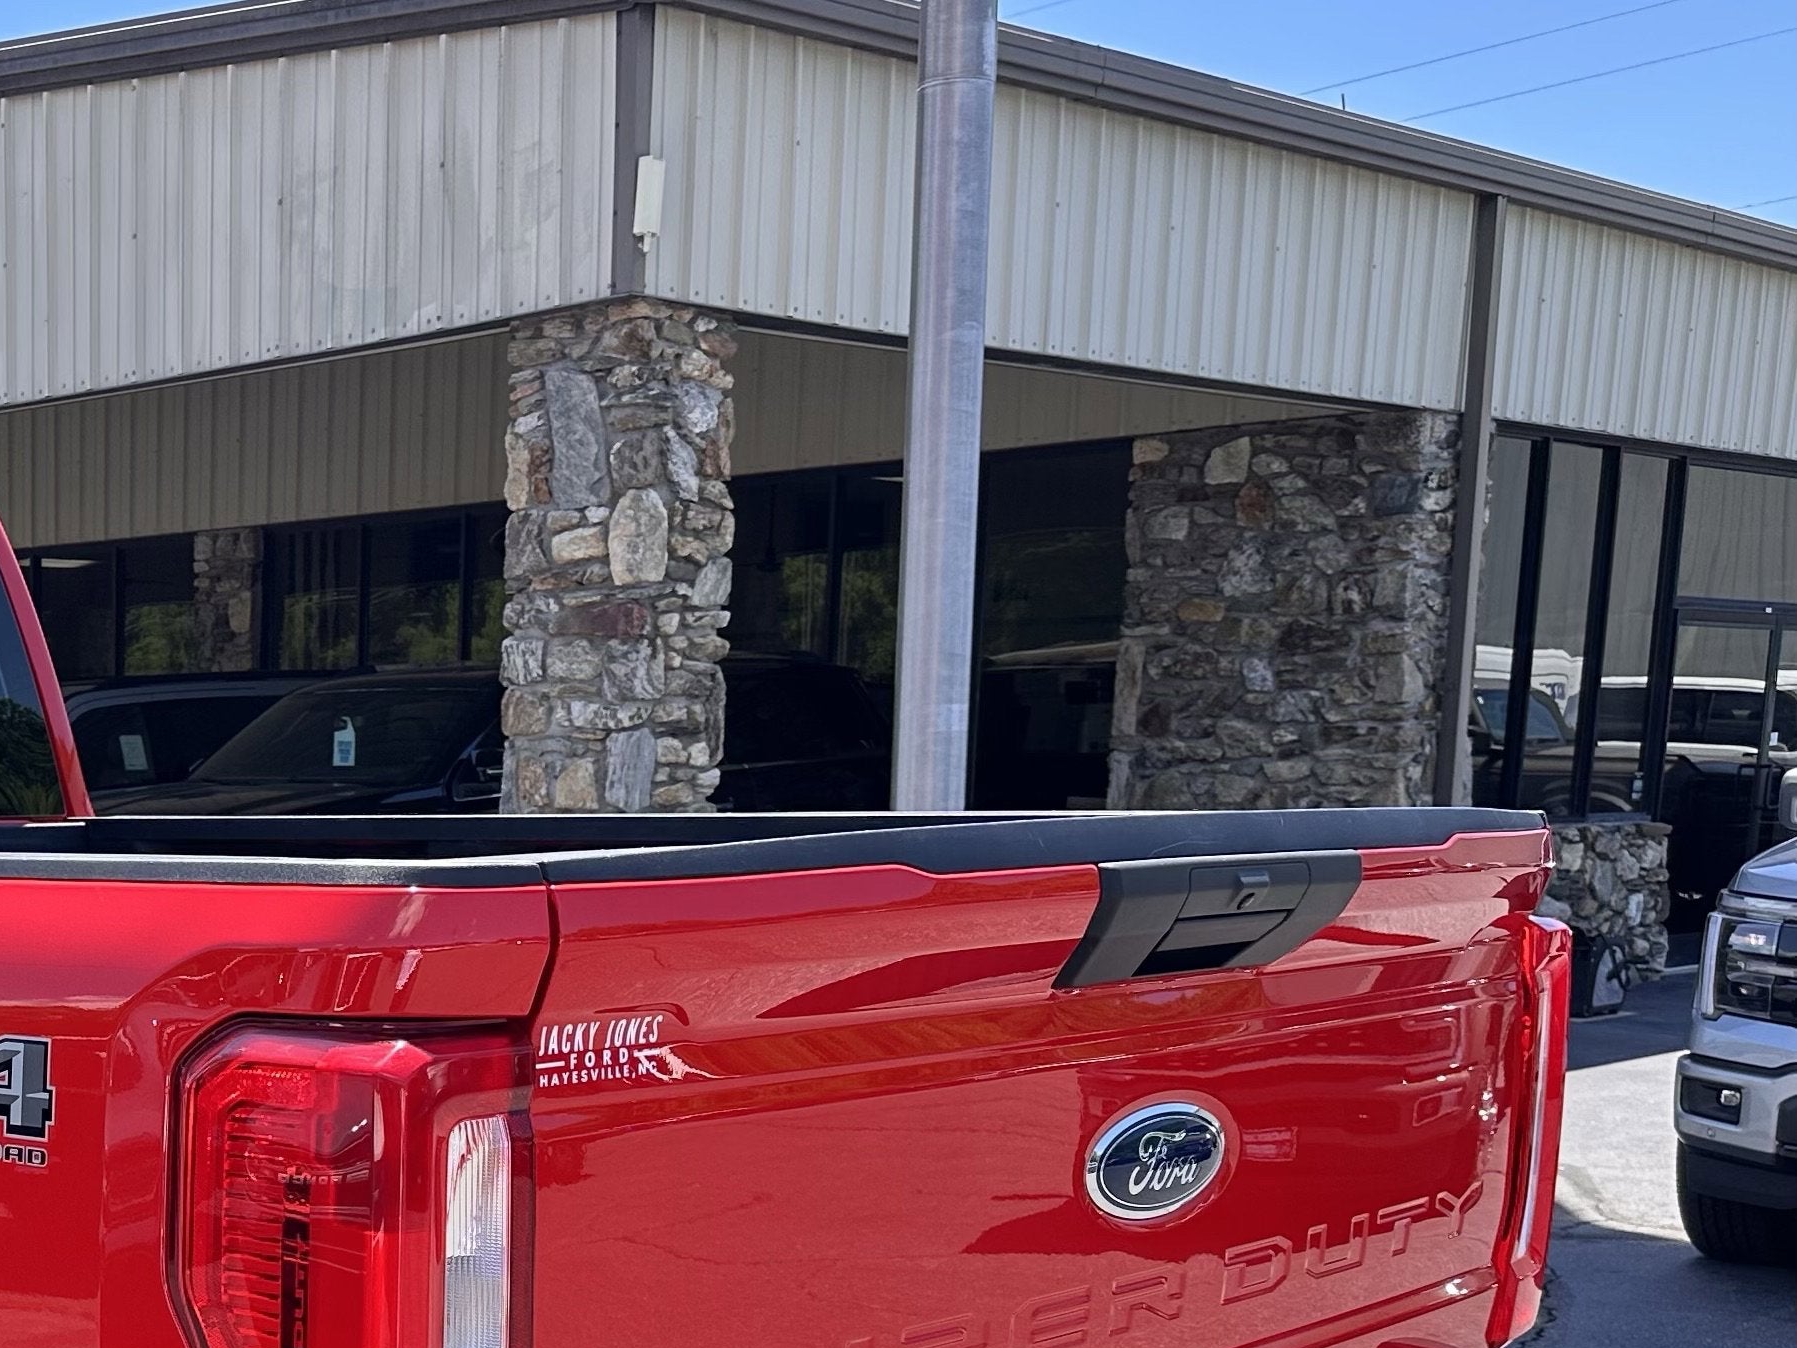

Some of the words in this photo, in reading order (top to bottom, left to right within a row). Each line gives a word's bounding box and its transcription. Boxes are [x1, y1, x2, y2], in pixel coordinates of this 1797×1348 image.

[538, 1021, 601, 1057] JACKY
[605, 1014, 664, 1048] JONES
[539, 1064, 636, 1088] HAYESVILLE,
[569, 1047, 629, 1070] FORD
[1128, 1129, 1199, 1195] Ford
[1220, 1180, 1484, 1305] DUTY
